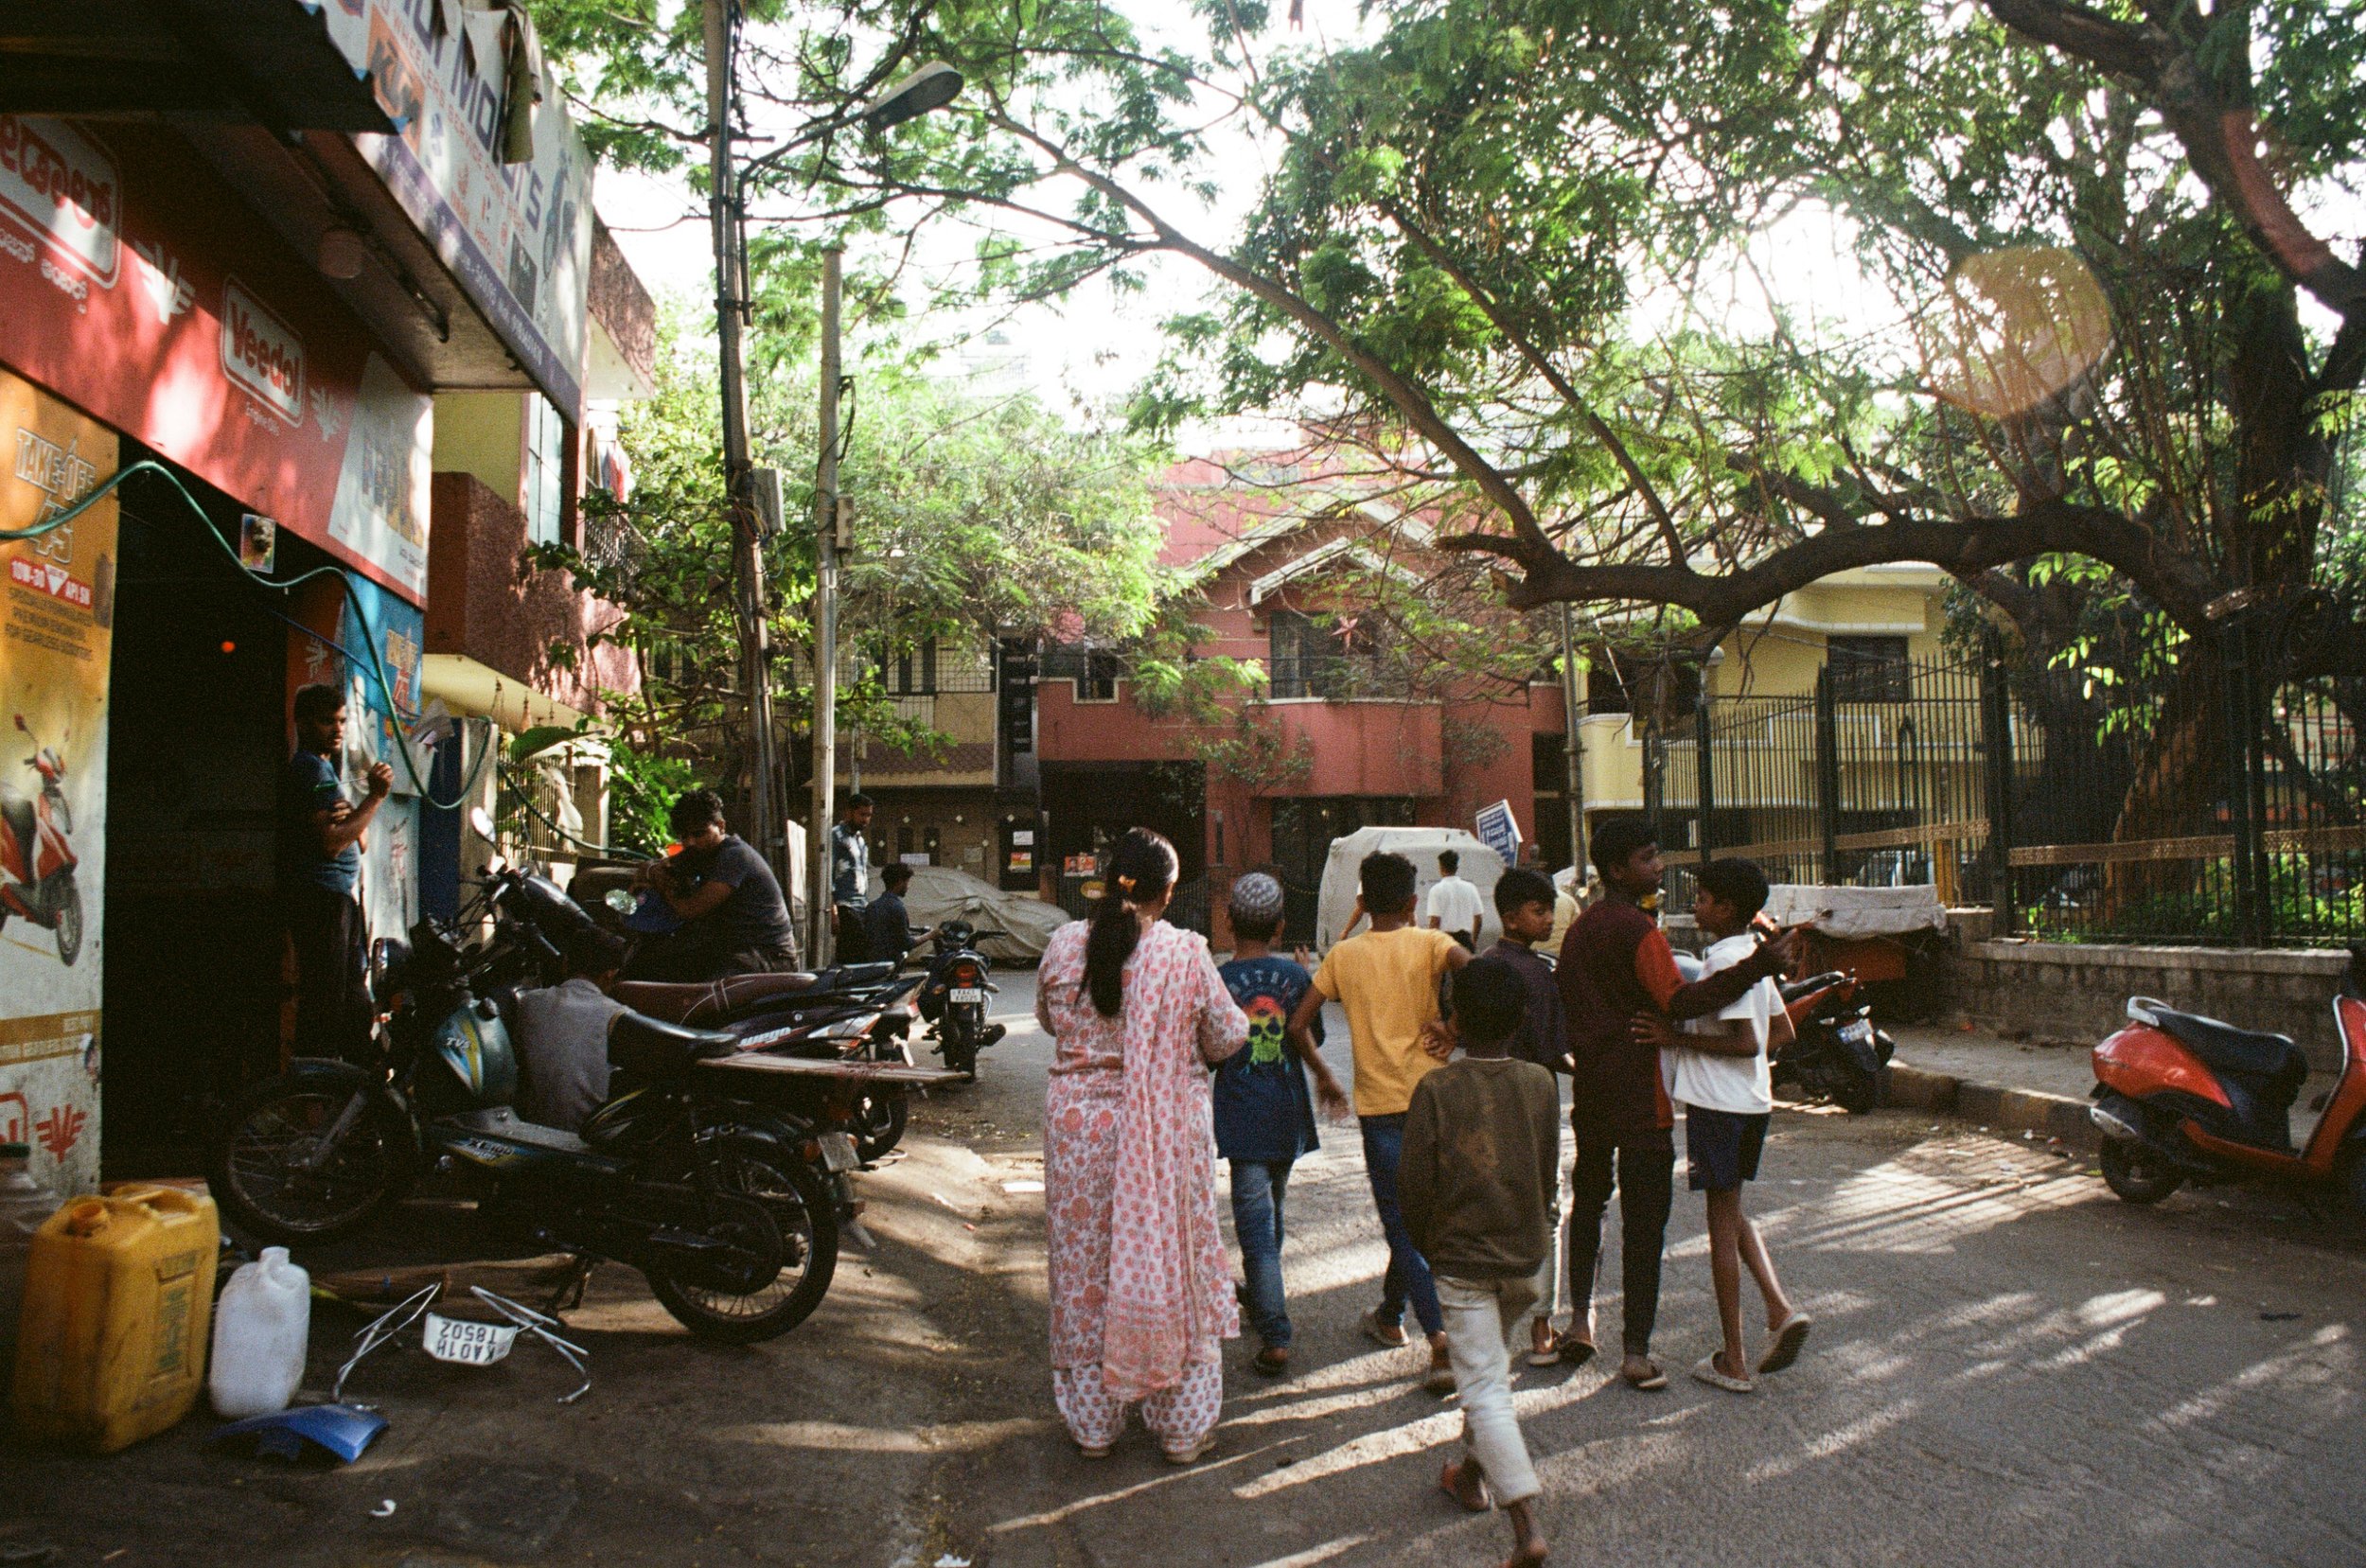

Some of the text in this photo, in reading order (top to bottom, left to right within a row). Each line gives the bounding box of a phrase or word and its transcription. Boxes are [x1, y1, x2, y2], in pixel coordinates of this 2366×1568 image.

[231, 302, 300, 401] Veedol
[445, 1036, 471, 1053] TVS
[440, 1319, 497, 1345] T8502
[436, 1339, 496, 1363] KA01H
